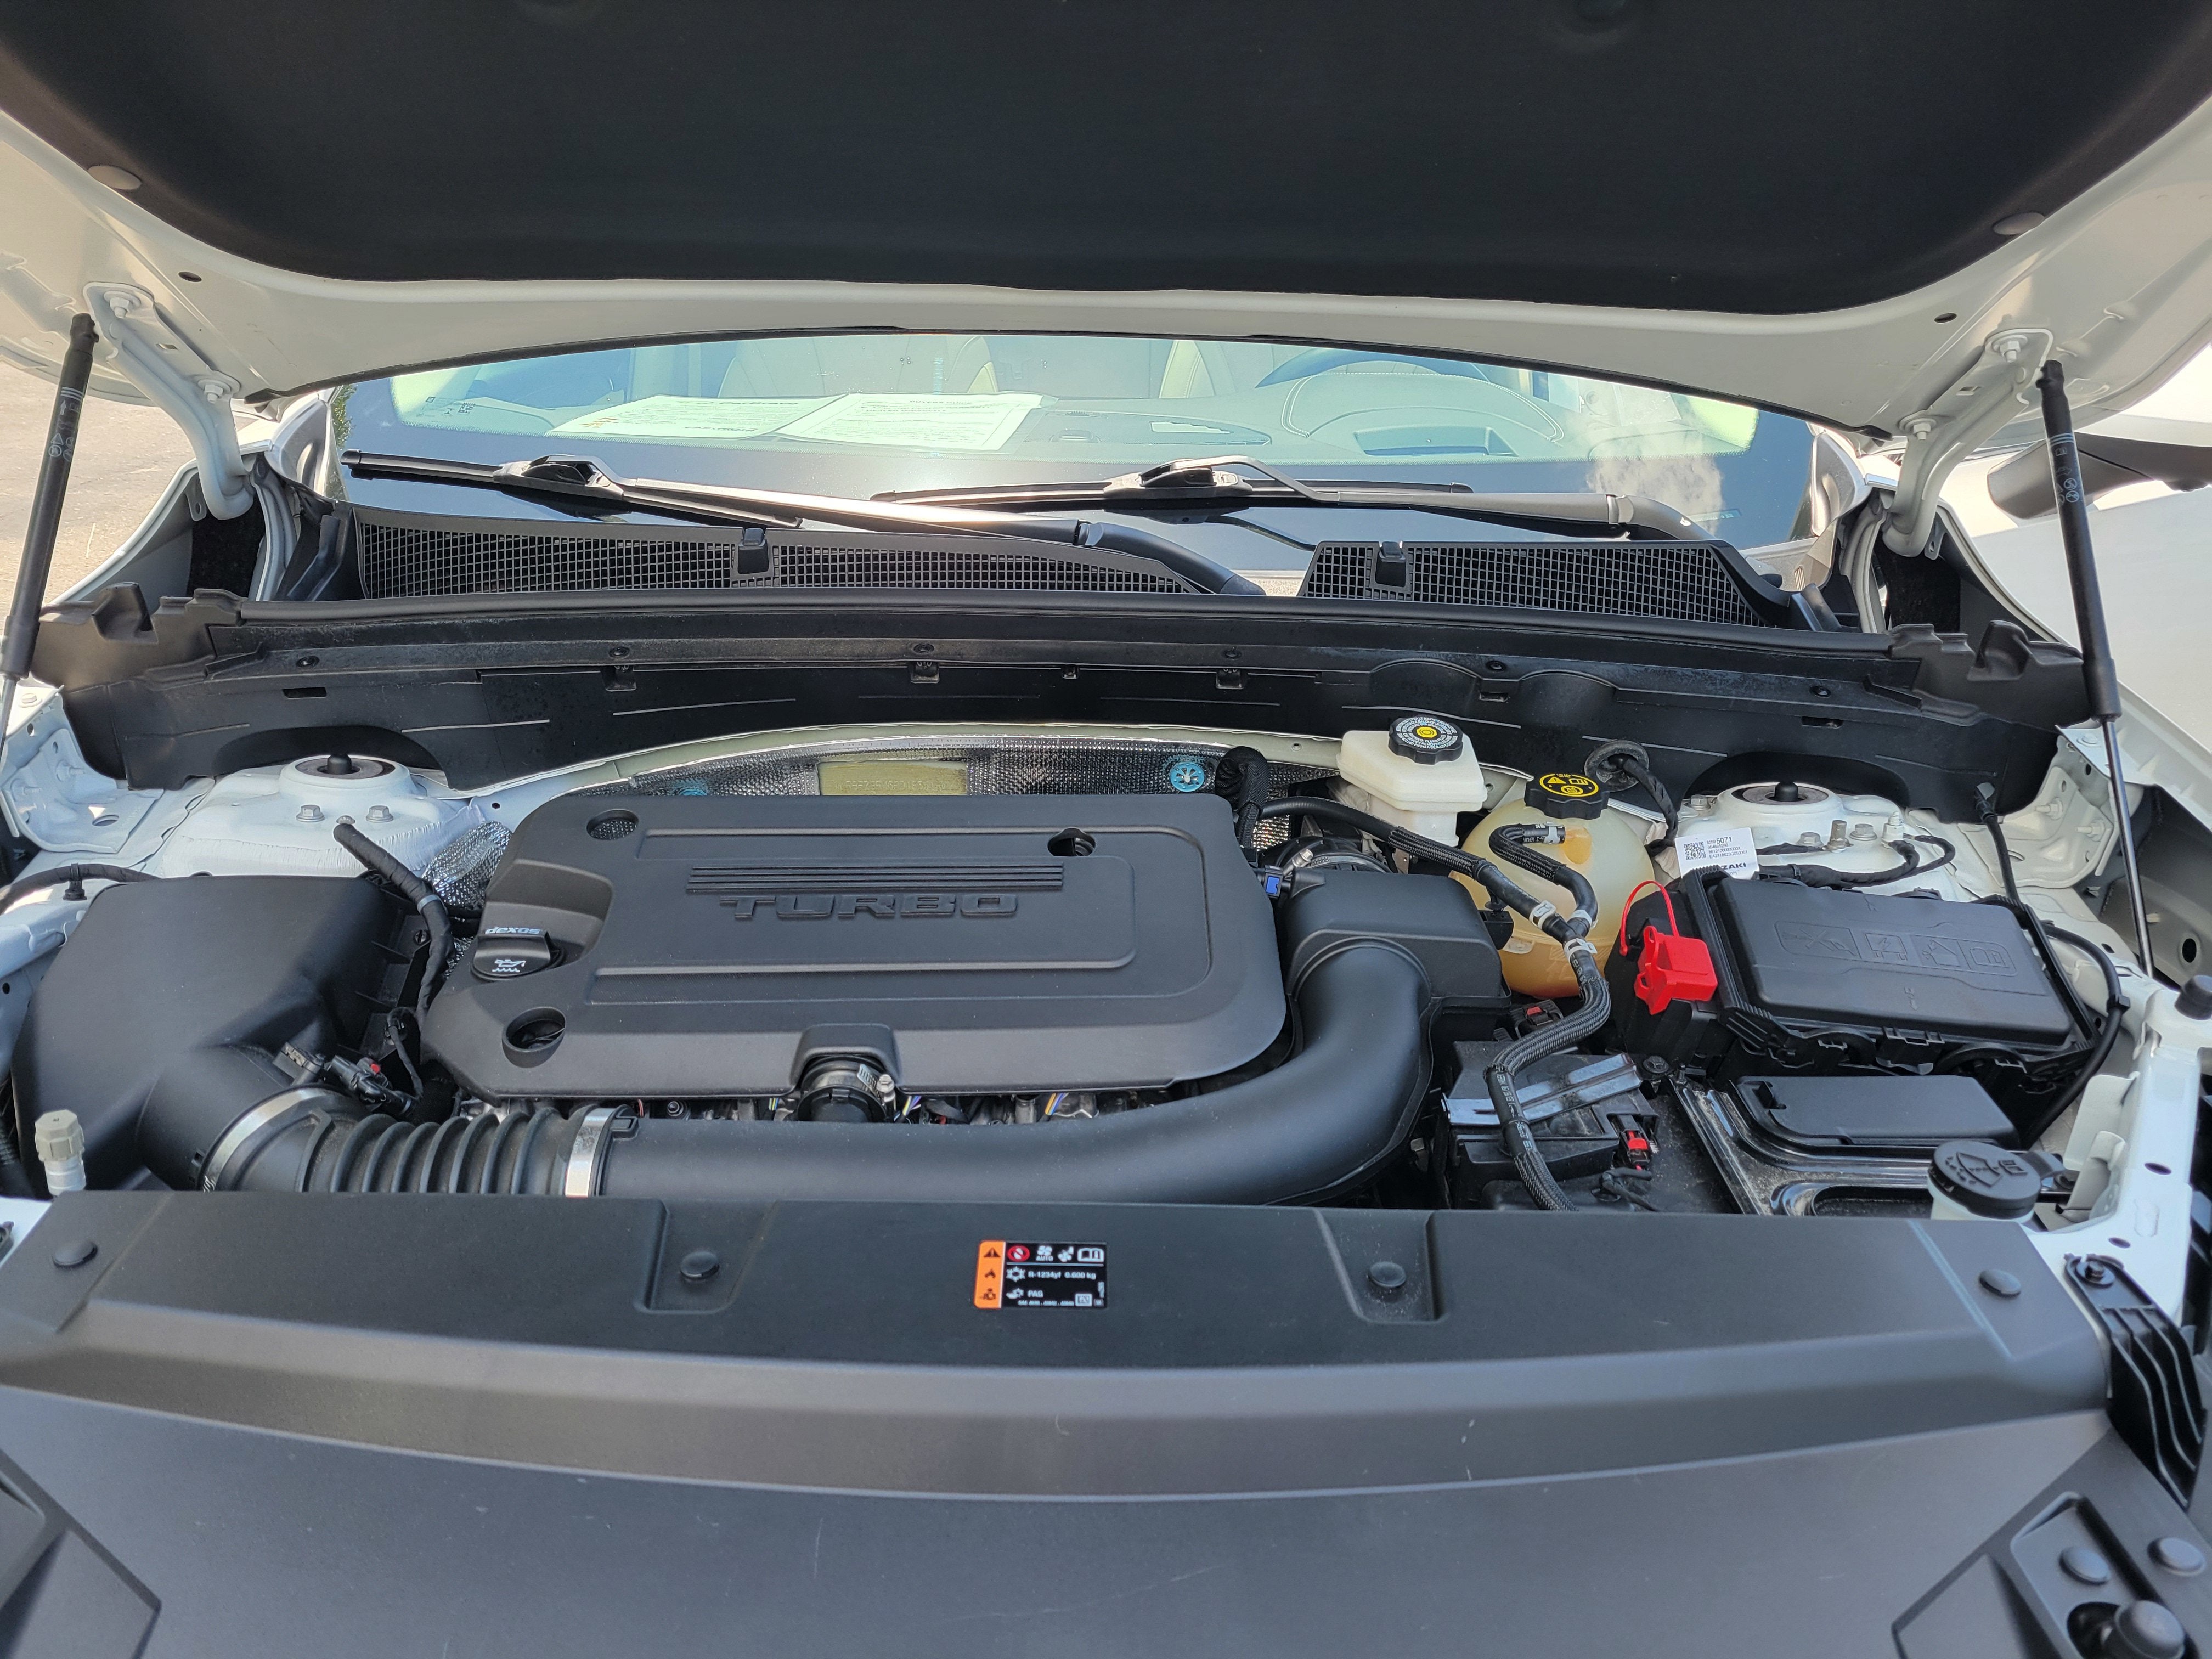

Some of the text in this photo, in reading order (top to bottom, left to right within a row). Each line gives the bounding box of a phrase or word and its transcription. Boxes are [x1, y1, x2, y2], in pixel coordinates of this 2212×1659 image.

[1716, 836, 1732, 844] 5071
[720, 894, 1018, 919] TURBO
[484, 927, 543, 935] dexos
[1028, 1271, 1062, 1279] R-1234yf
[1086, 1272, 1096, 1280] kg
[1027, 1290, 1043, 1298] PAG
